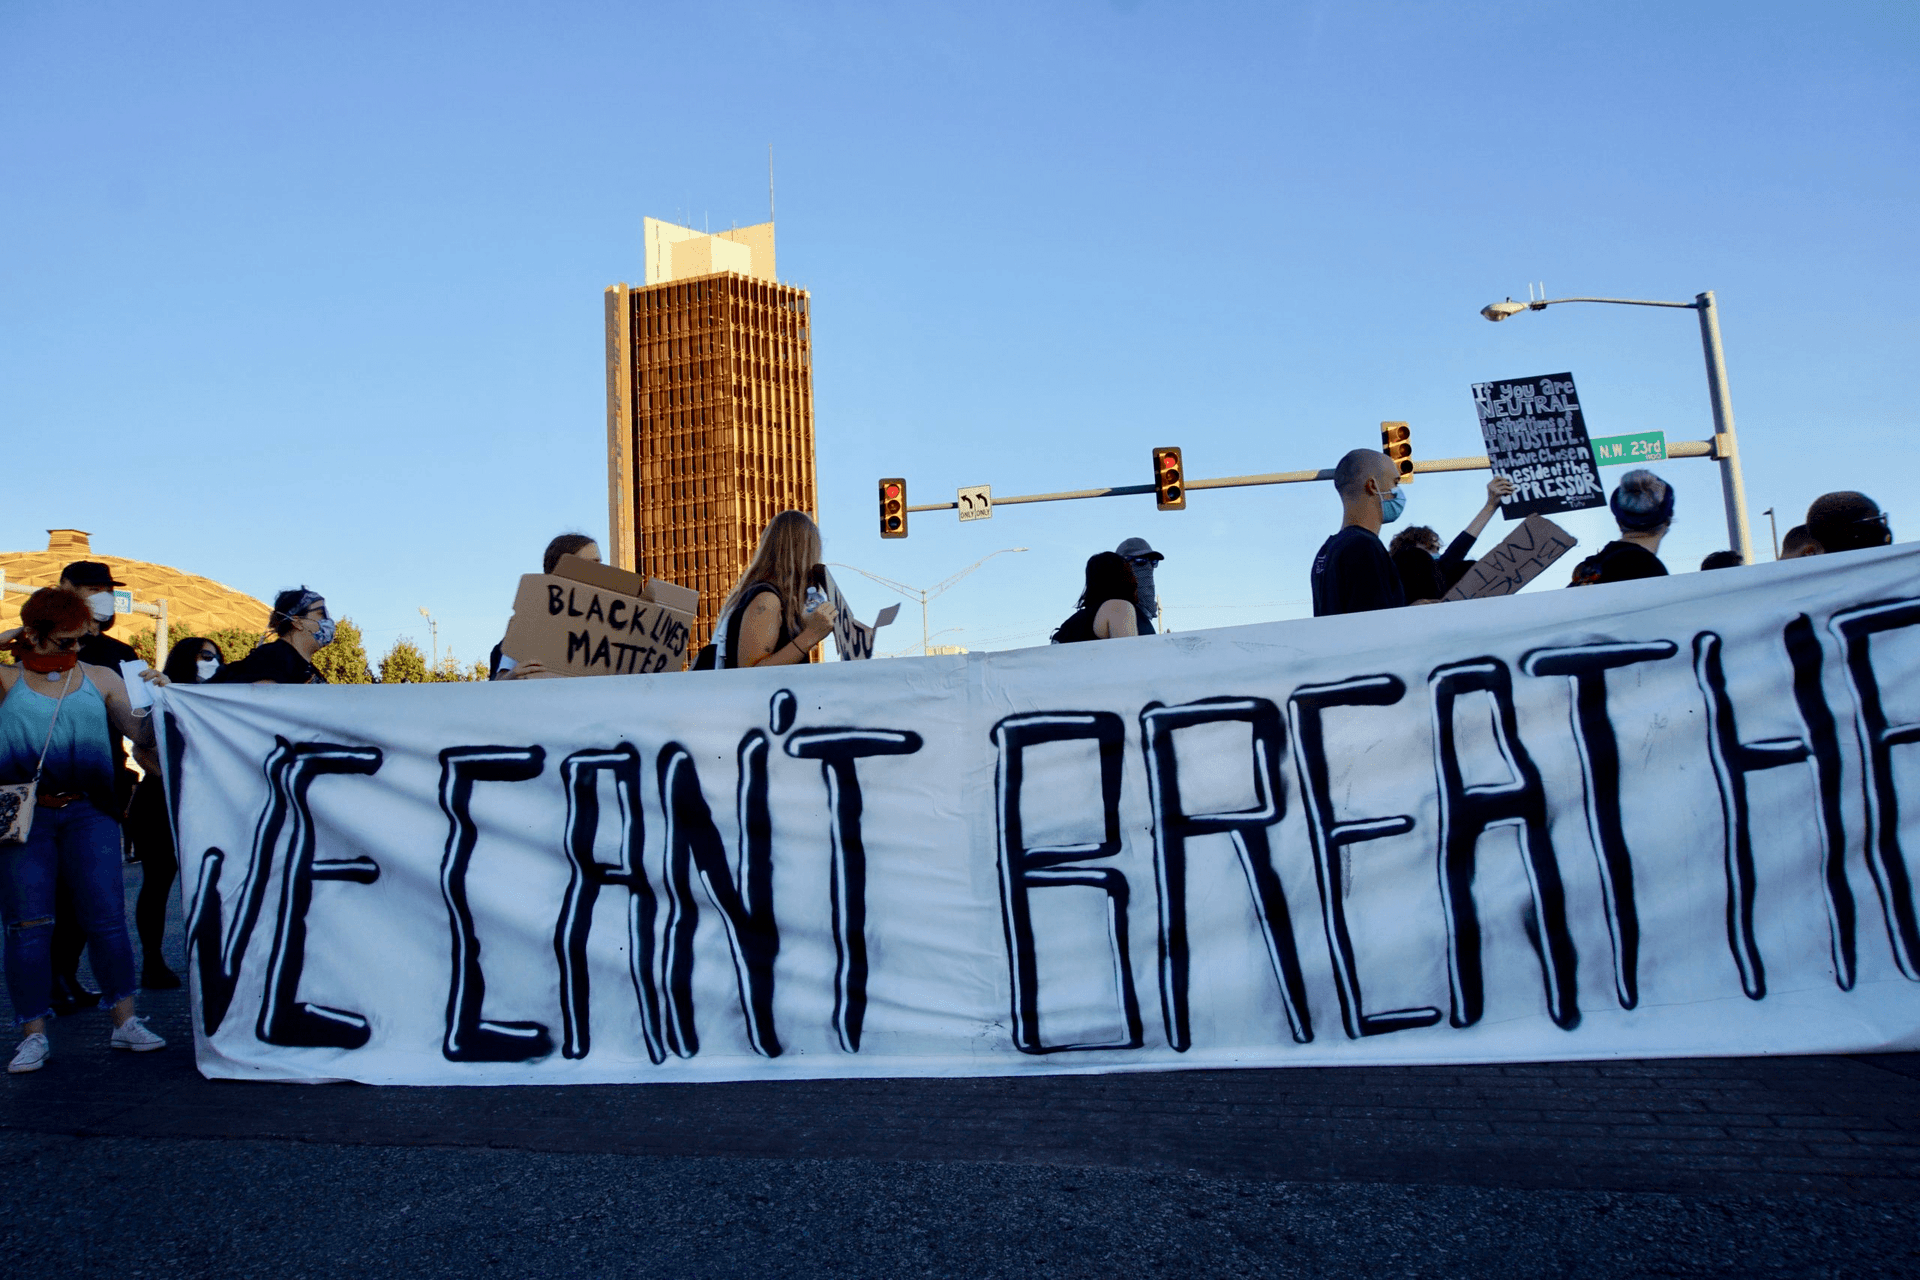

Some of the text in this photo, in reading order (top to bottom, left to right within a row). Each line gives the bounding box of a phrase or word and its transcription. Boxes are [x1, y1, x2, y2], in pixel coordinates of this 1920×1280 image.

[1473, 379, 1574, 401] If you are
[1476, 394, 1579, 419] NEUTRAL
[1630, 440, 1662, 455] 23rd
[1522, 463, 1550, 480] side
[1563, 460, 1590, 475] the
[1485, 537, 1569, 595] BLAC
[547, 584, 689, 657] BLACK LIVES
[438, 687, 923, 1064] CAN'T
